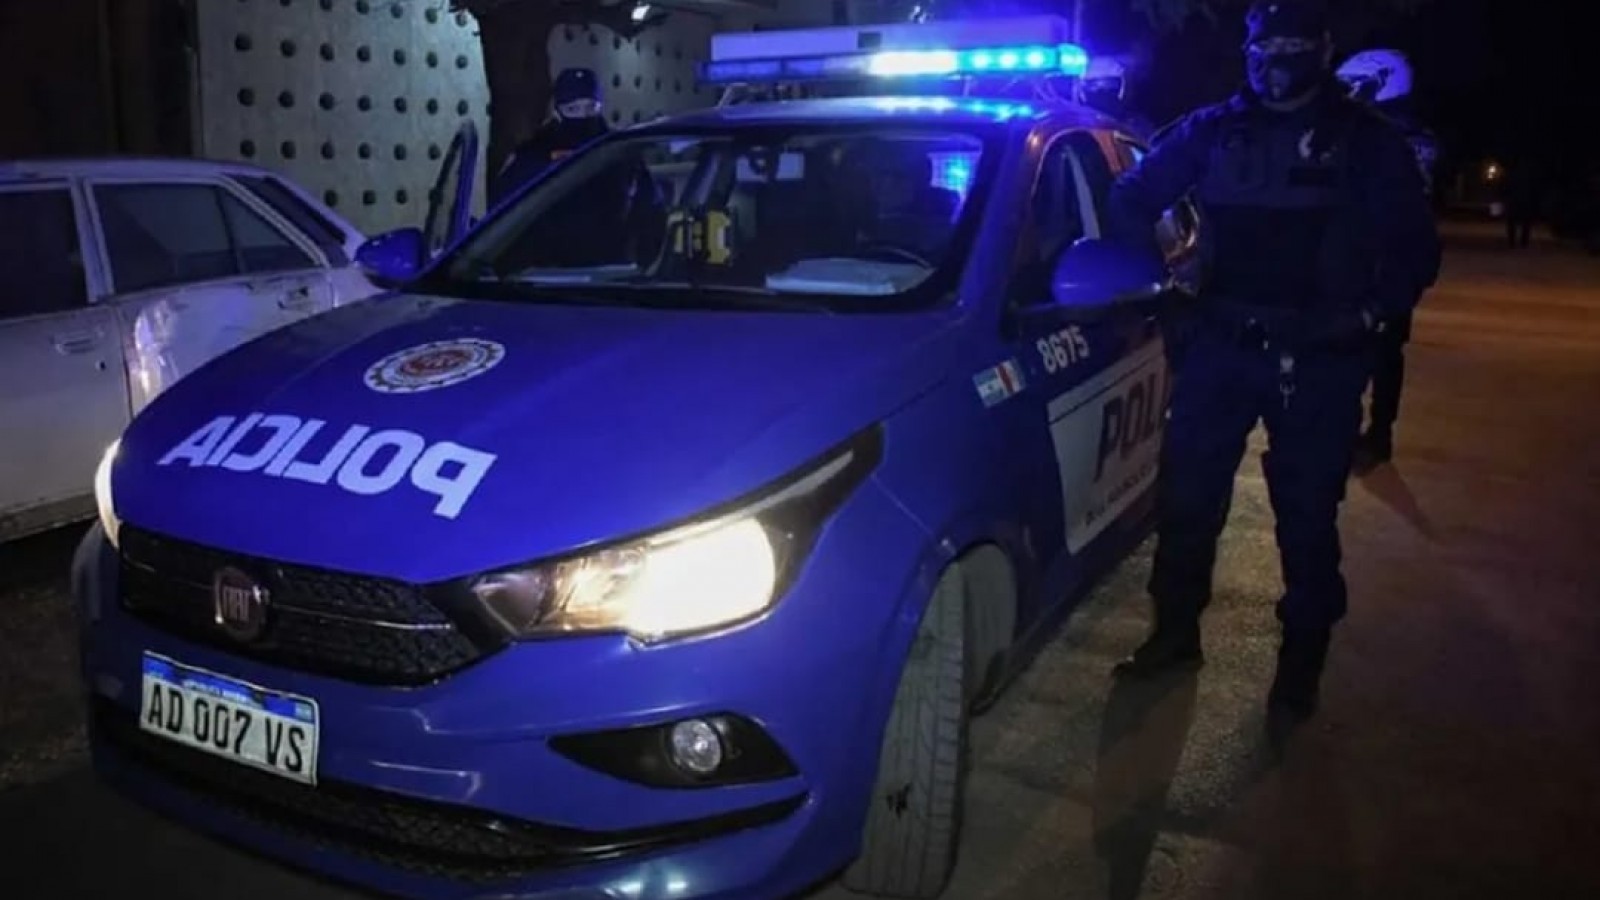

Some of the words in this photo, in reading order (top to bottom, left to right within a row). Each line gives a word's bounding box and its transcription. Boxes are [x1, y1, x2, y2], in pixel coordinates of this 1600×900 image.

[1036, 325, 1090, 374] 8675
[1093, 373, 1157, 483] POL
[148, 684, 184, 734] AD
[193, 697, 252, 754] 007
[265, 717, 306, 772] VS
